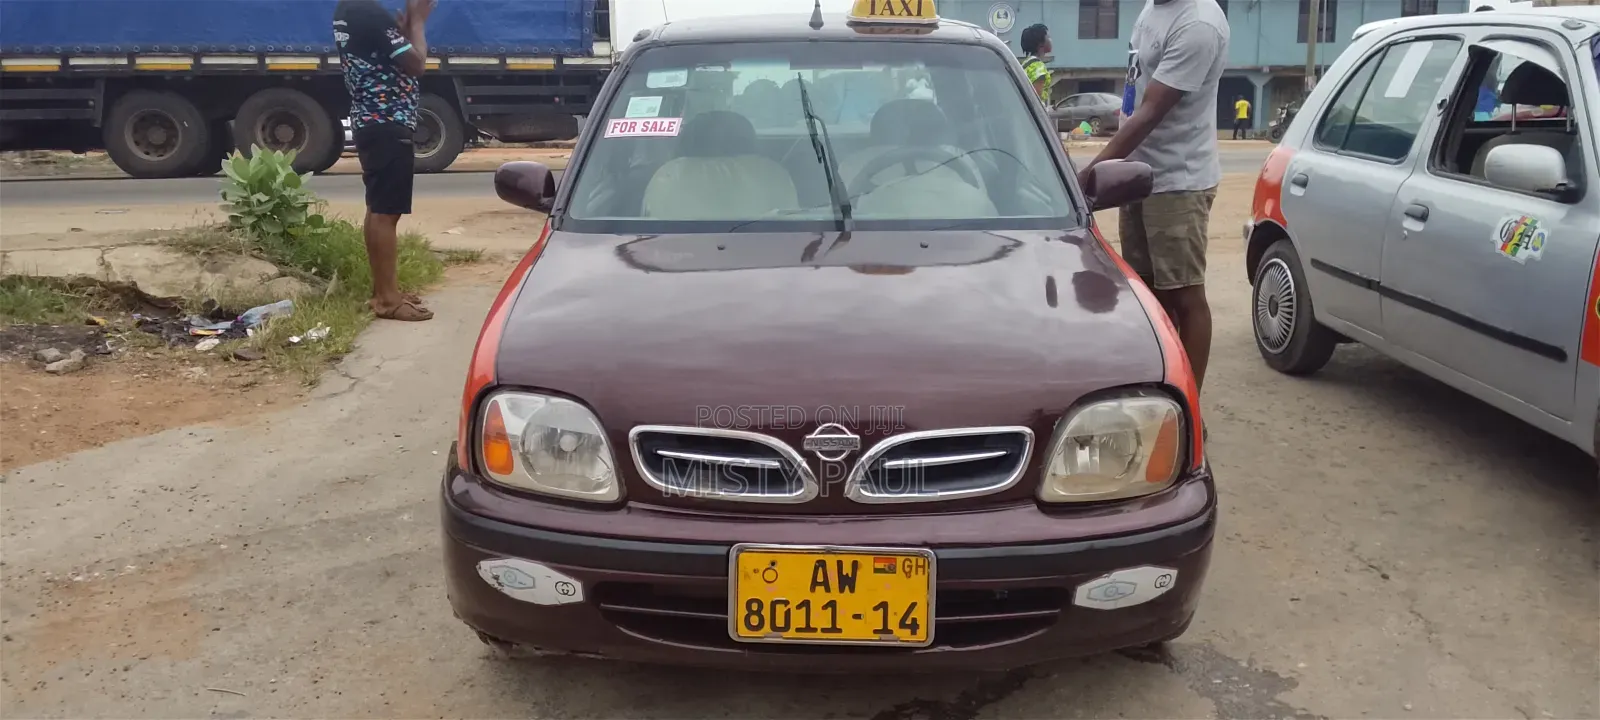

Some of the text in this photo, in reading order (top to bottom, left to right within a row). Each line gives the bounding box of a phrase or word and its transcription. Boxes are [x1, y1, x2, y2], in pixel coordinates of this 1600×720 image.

[868, 0, 924, 17] TAXI
[610, 121, 676, 133] FOR SALE
[809, 439, 854, 448] NISSAN
[809, 559, 859, 594] AW
[902, 557, 926, 579] GH
[743, 597, 920, 636] 8011-14
